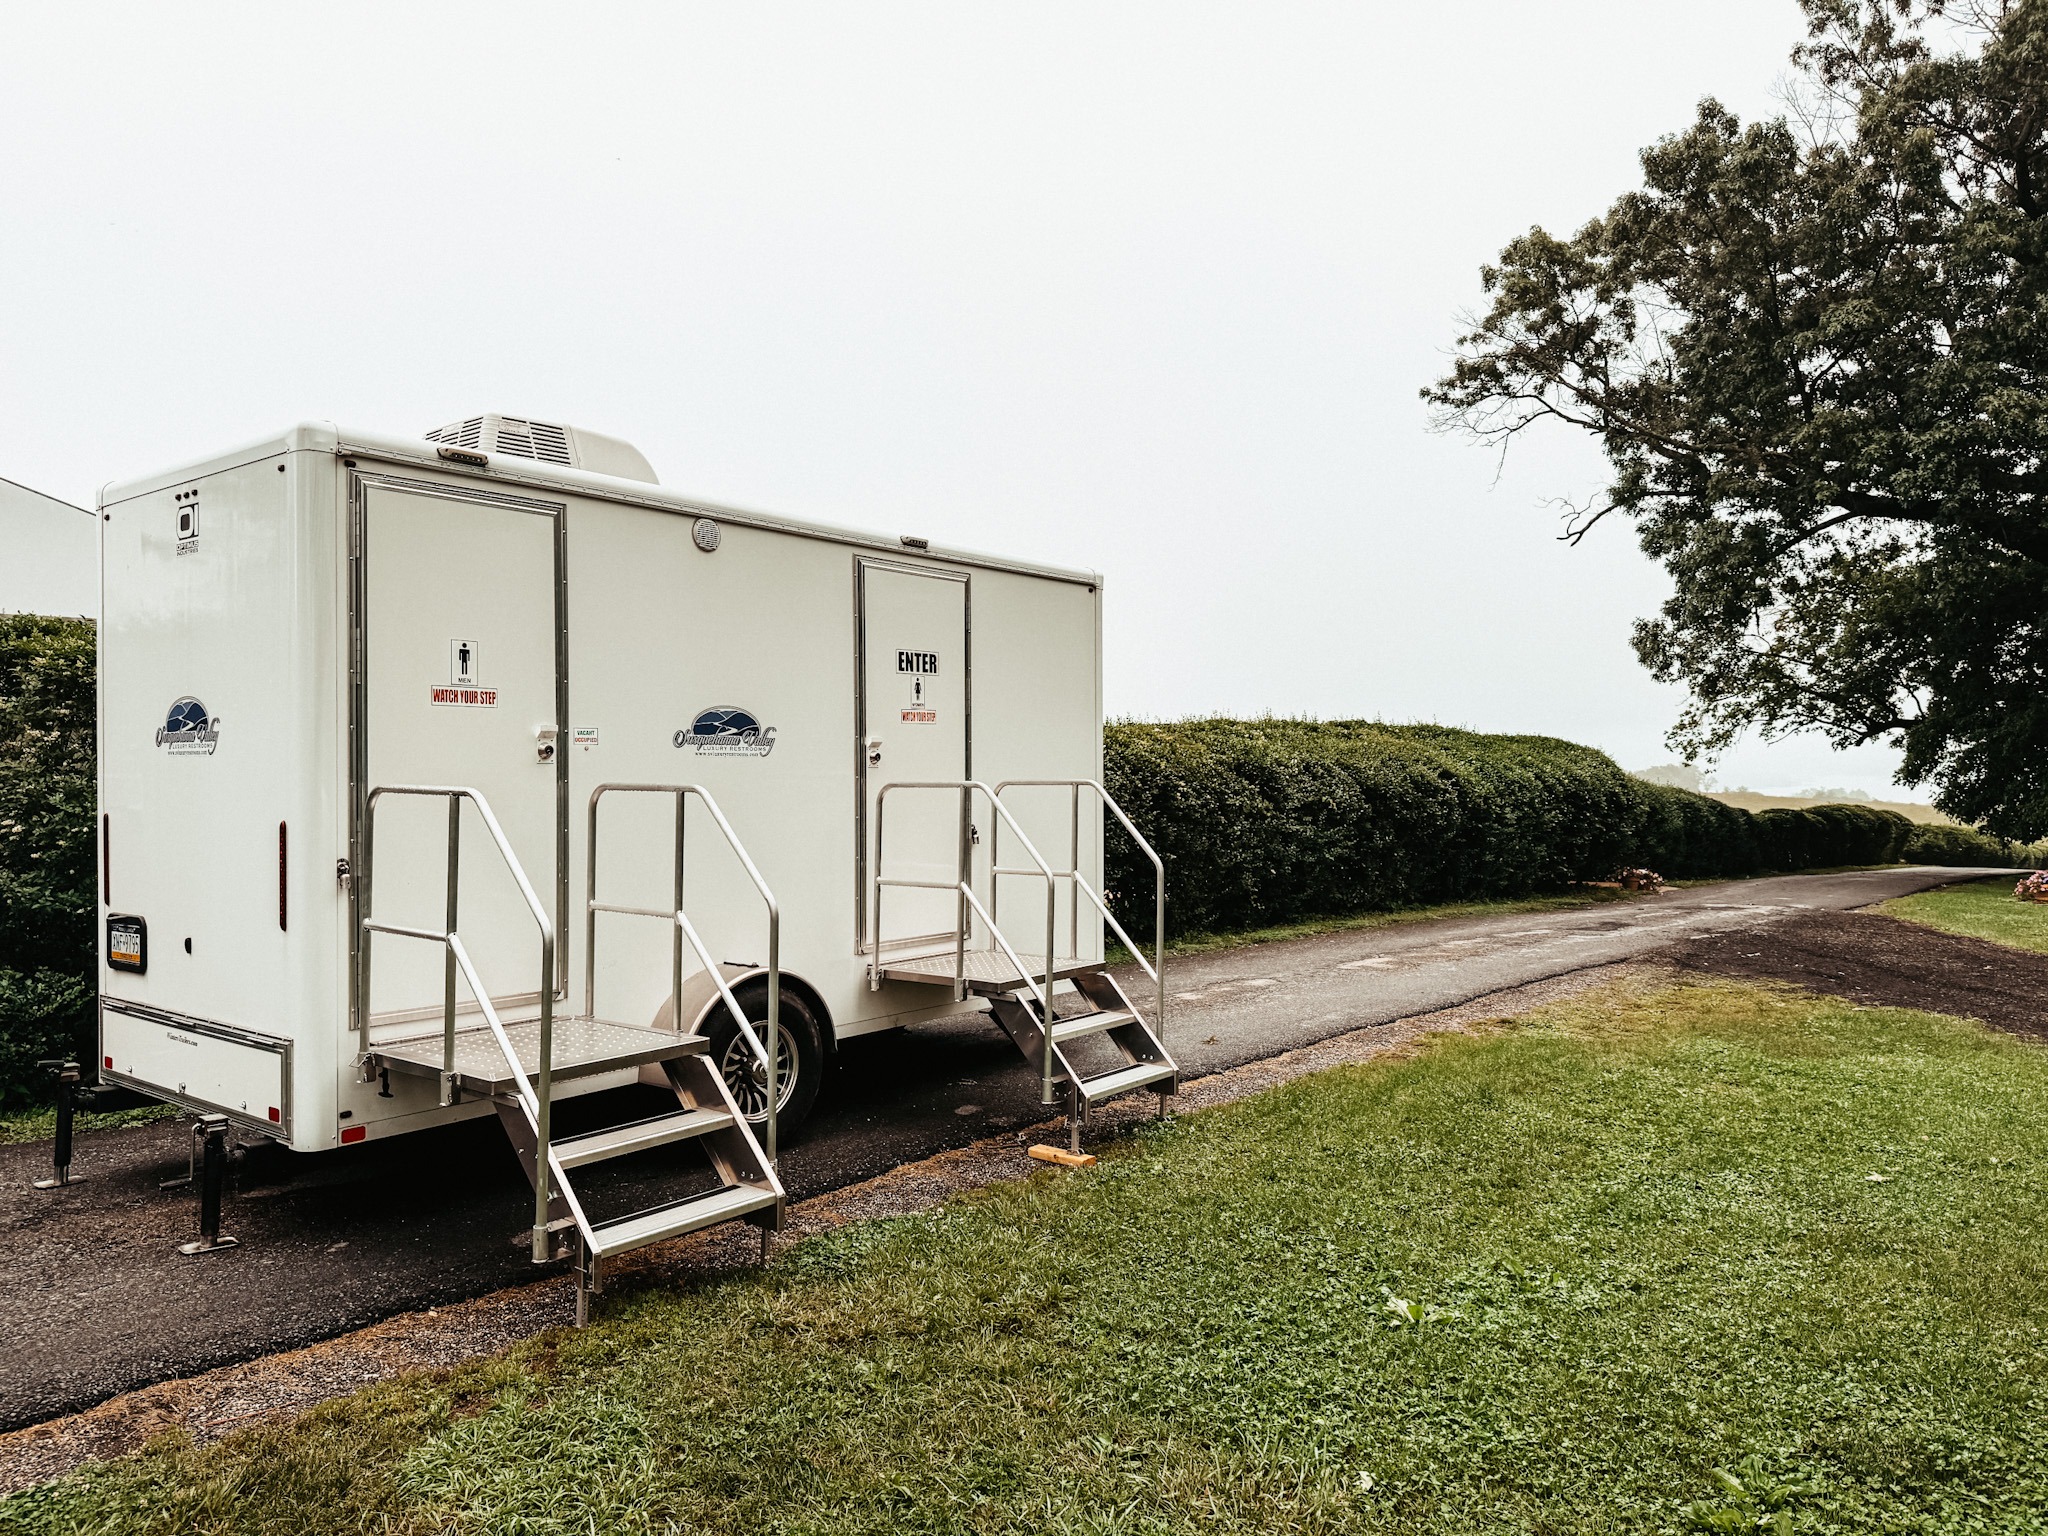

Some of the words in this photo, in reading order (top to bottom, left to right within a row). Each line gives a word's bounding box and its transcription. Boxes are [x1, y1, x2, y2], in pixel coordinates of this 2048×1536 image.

[898, 651, 937, 674] ENTER
[432, 688, 459, 703] WATCH
[460, 690, 479, 704] YOUR
[480, 691, 496, 705] STEP
[902, 711, 916, 722] WATCH
[916, 712, 926, 722] YOUR
[927, 712, 936, 722] STEP
[155, 726, 196, 750] Susquehanna
[196, 717, 221, 755] Valley
[672, 729, 741, 751] Susquehanna
[742, 726, 778, 757] Valley
